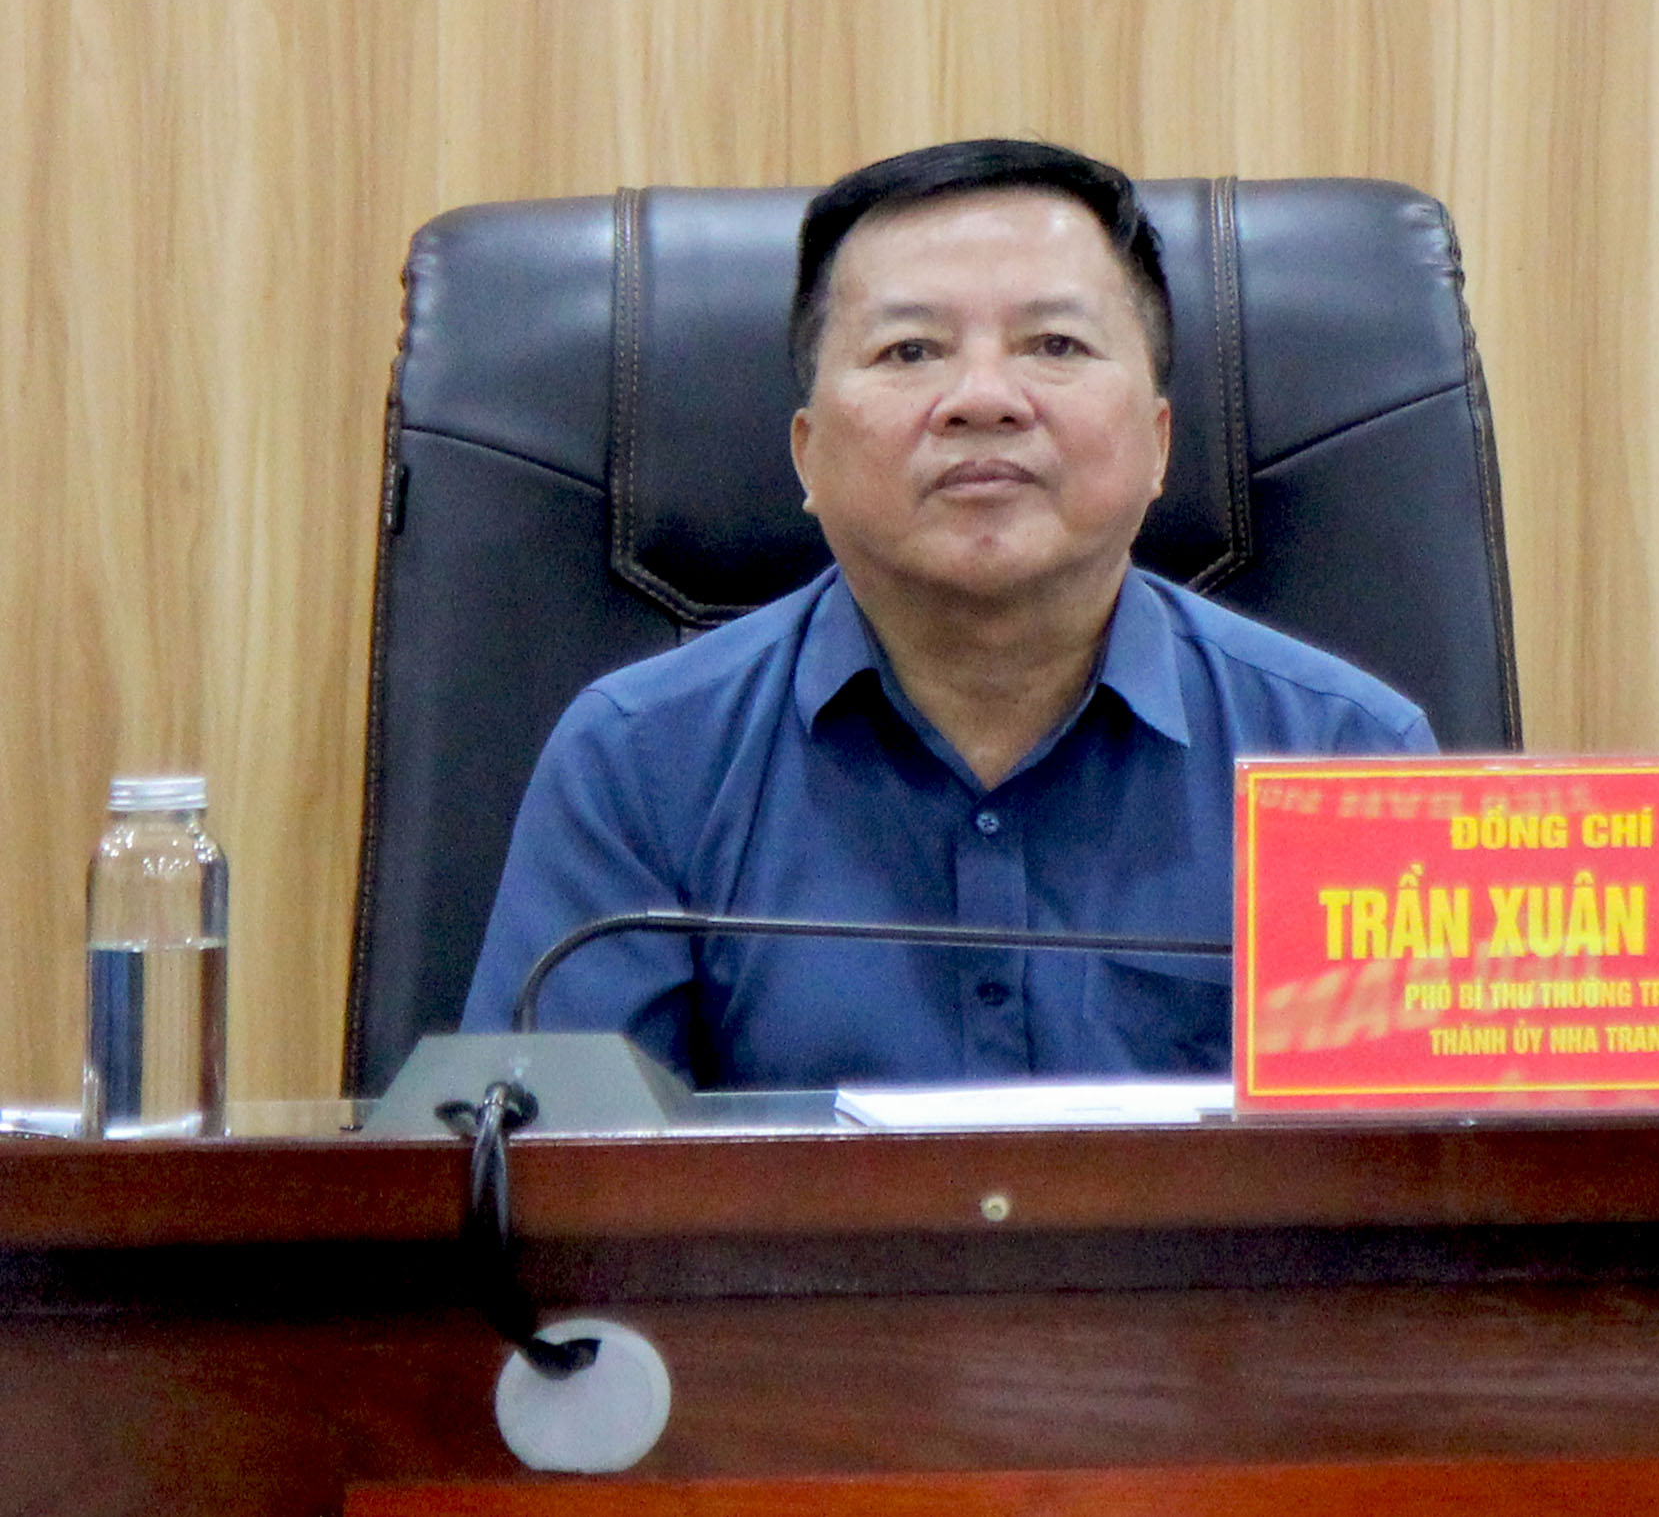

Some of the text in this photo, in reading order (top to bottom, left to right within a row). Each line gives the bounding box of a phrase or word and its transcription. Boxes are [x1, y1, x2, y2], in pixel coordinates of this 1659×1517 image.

[1450, 804, 1654, 850] ĐỒNG CHÍ
[1319, 863, 1471, 961] TRẦN
[1490, 870, 1646, 957] XUÂN
[1405, 979, 1451, 1010] PHÓ
[1430, 1022, 1507, 1056] THÀNH
[1513, 1018, 1543, 1054] ỦY
[1550, 1027, 1599, 1054] NHA
